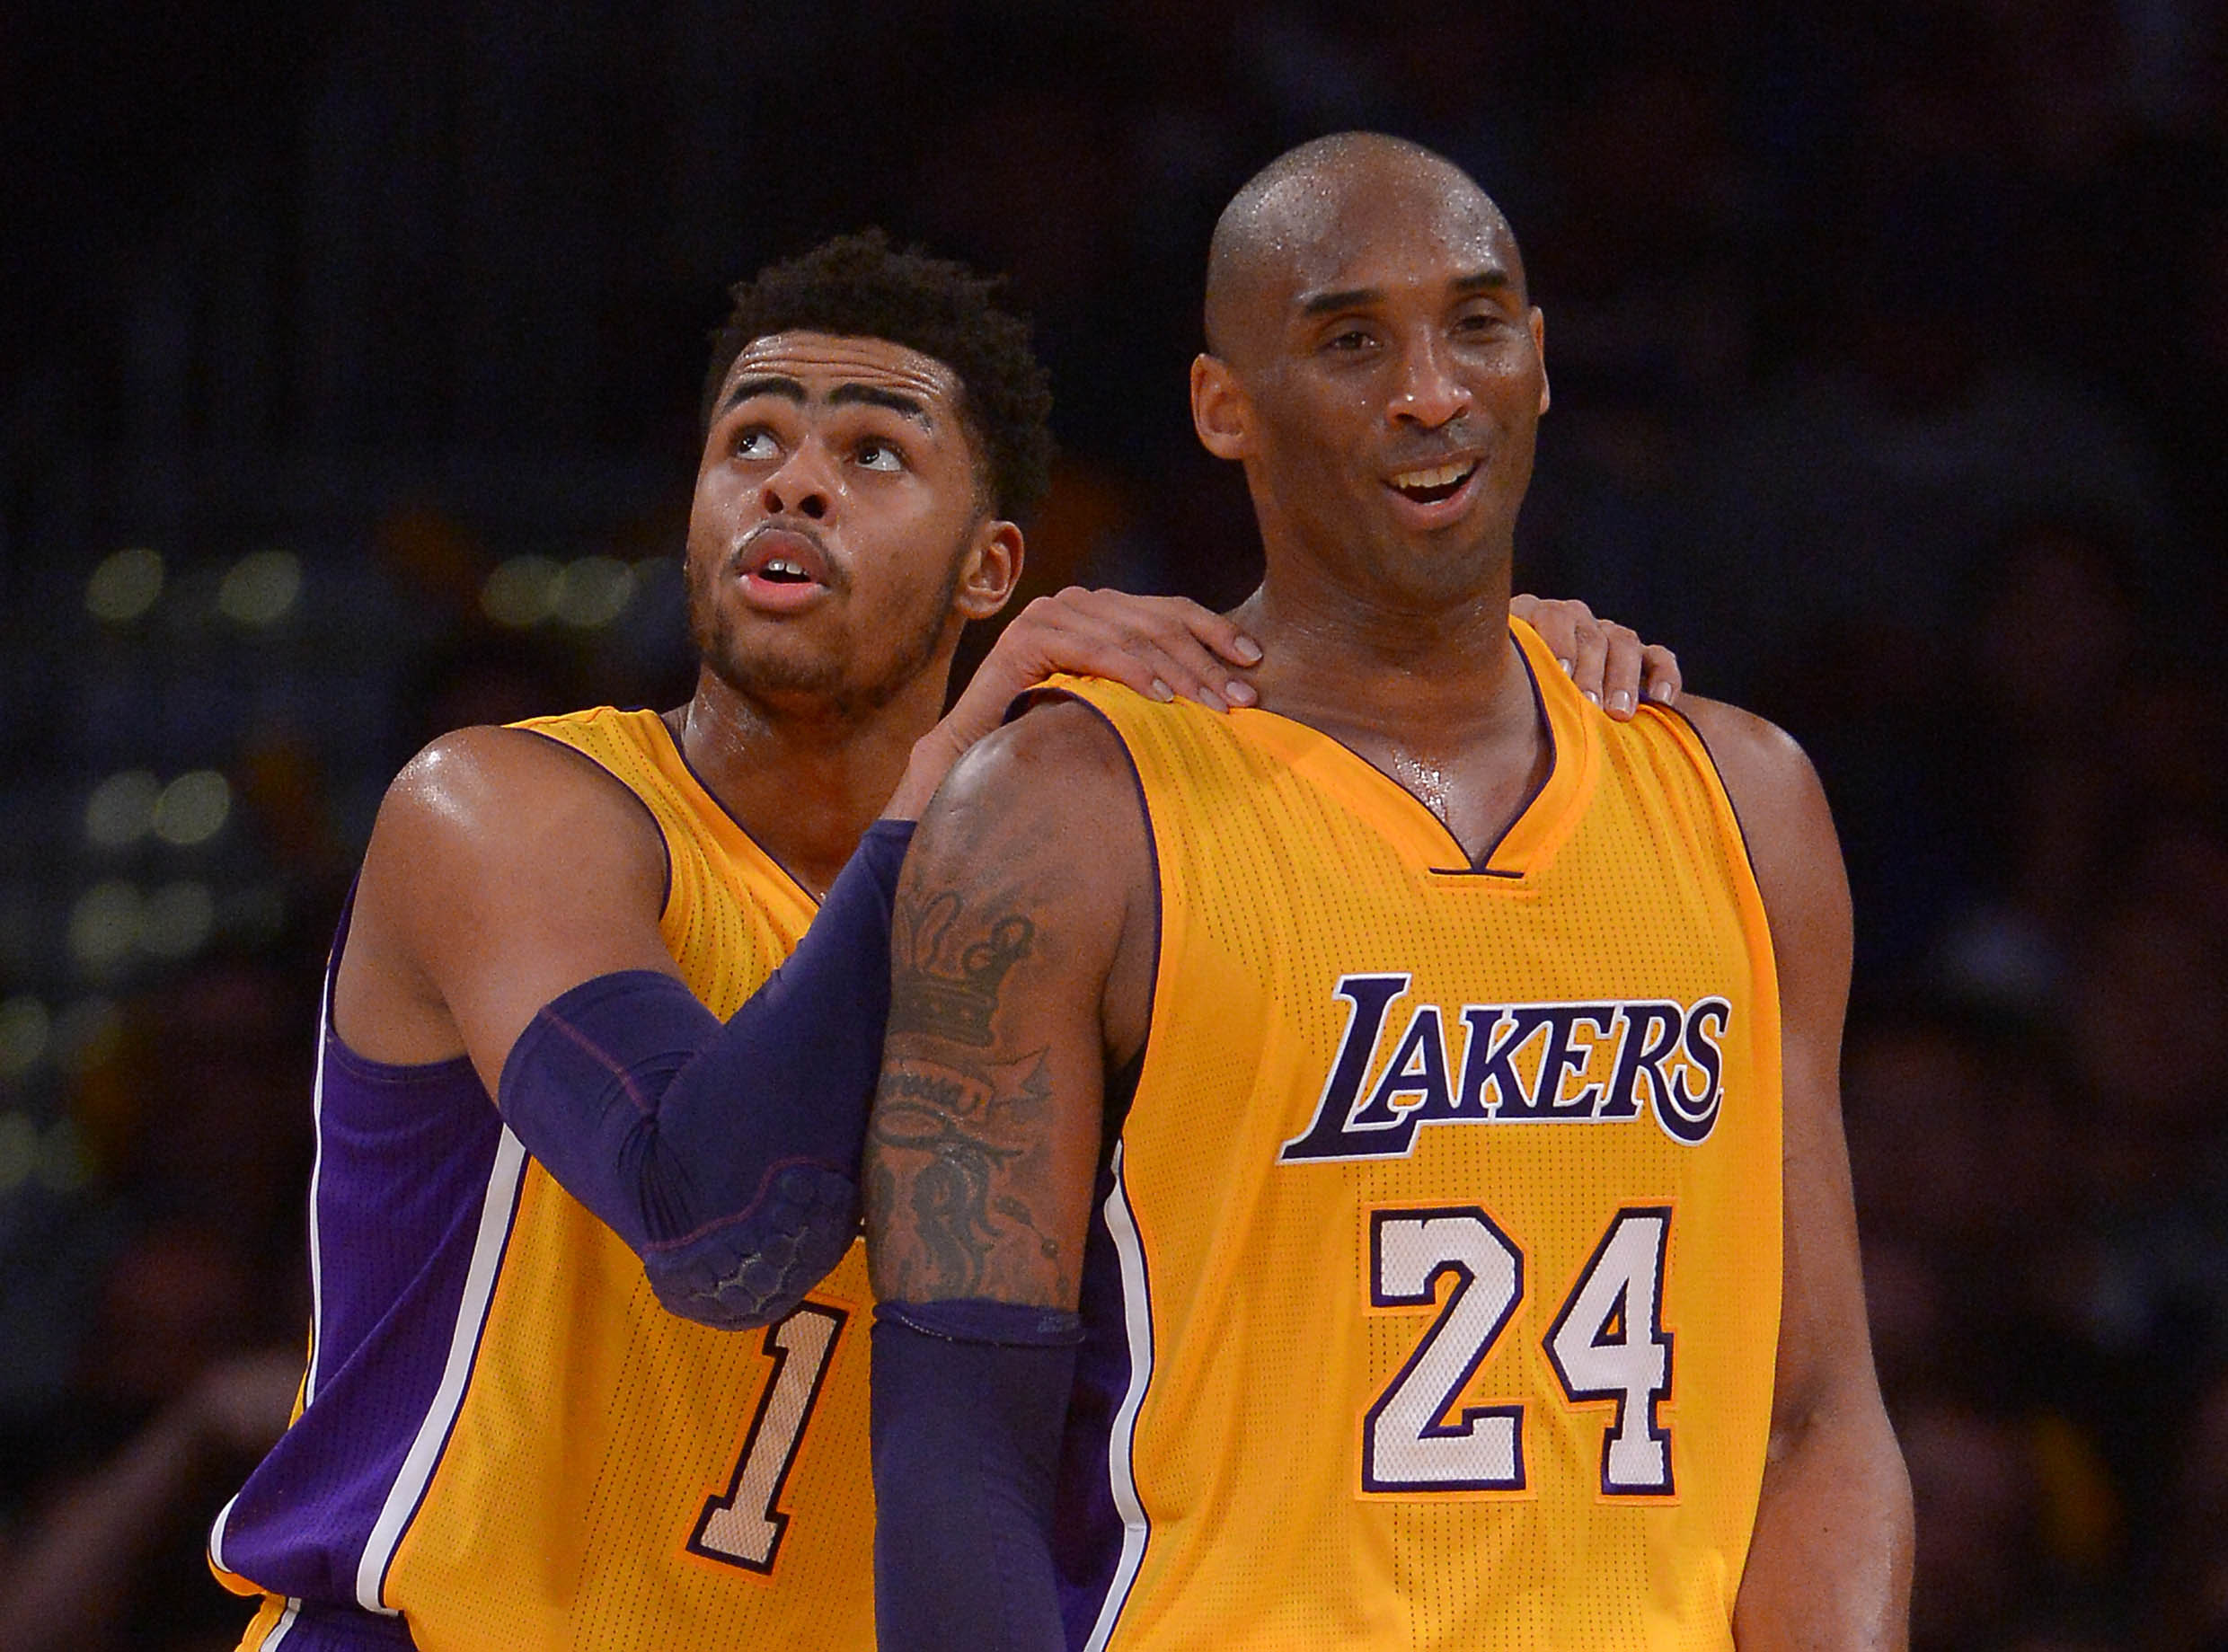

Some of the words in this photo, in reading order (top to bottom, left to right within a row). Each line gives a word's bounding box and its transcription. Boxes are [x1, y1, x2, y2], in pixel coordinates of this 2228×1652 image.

[1276, 972, 1732, 1164] LAKERS
[684, 1299, 851, 1577] 1
[1360, 1204, 1677, 1497] 24
